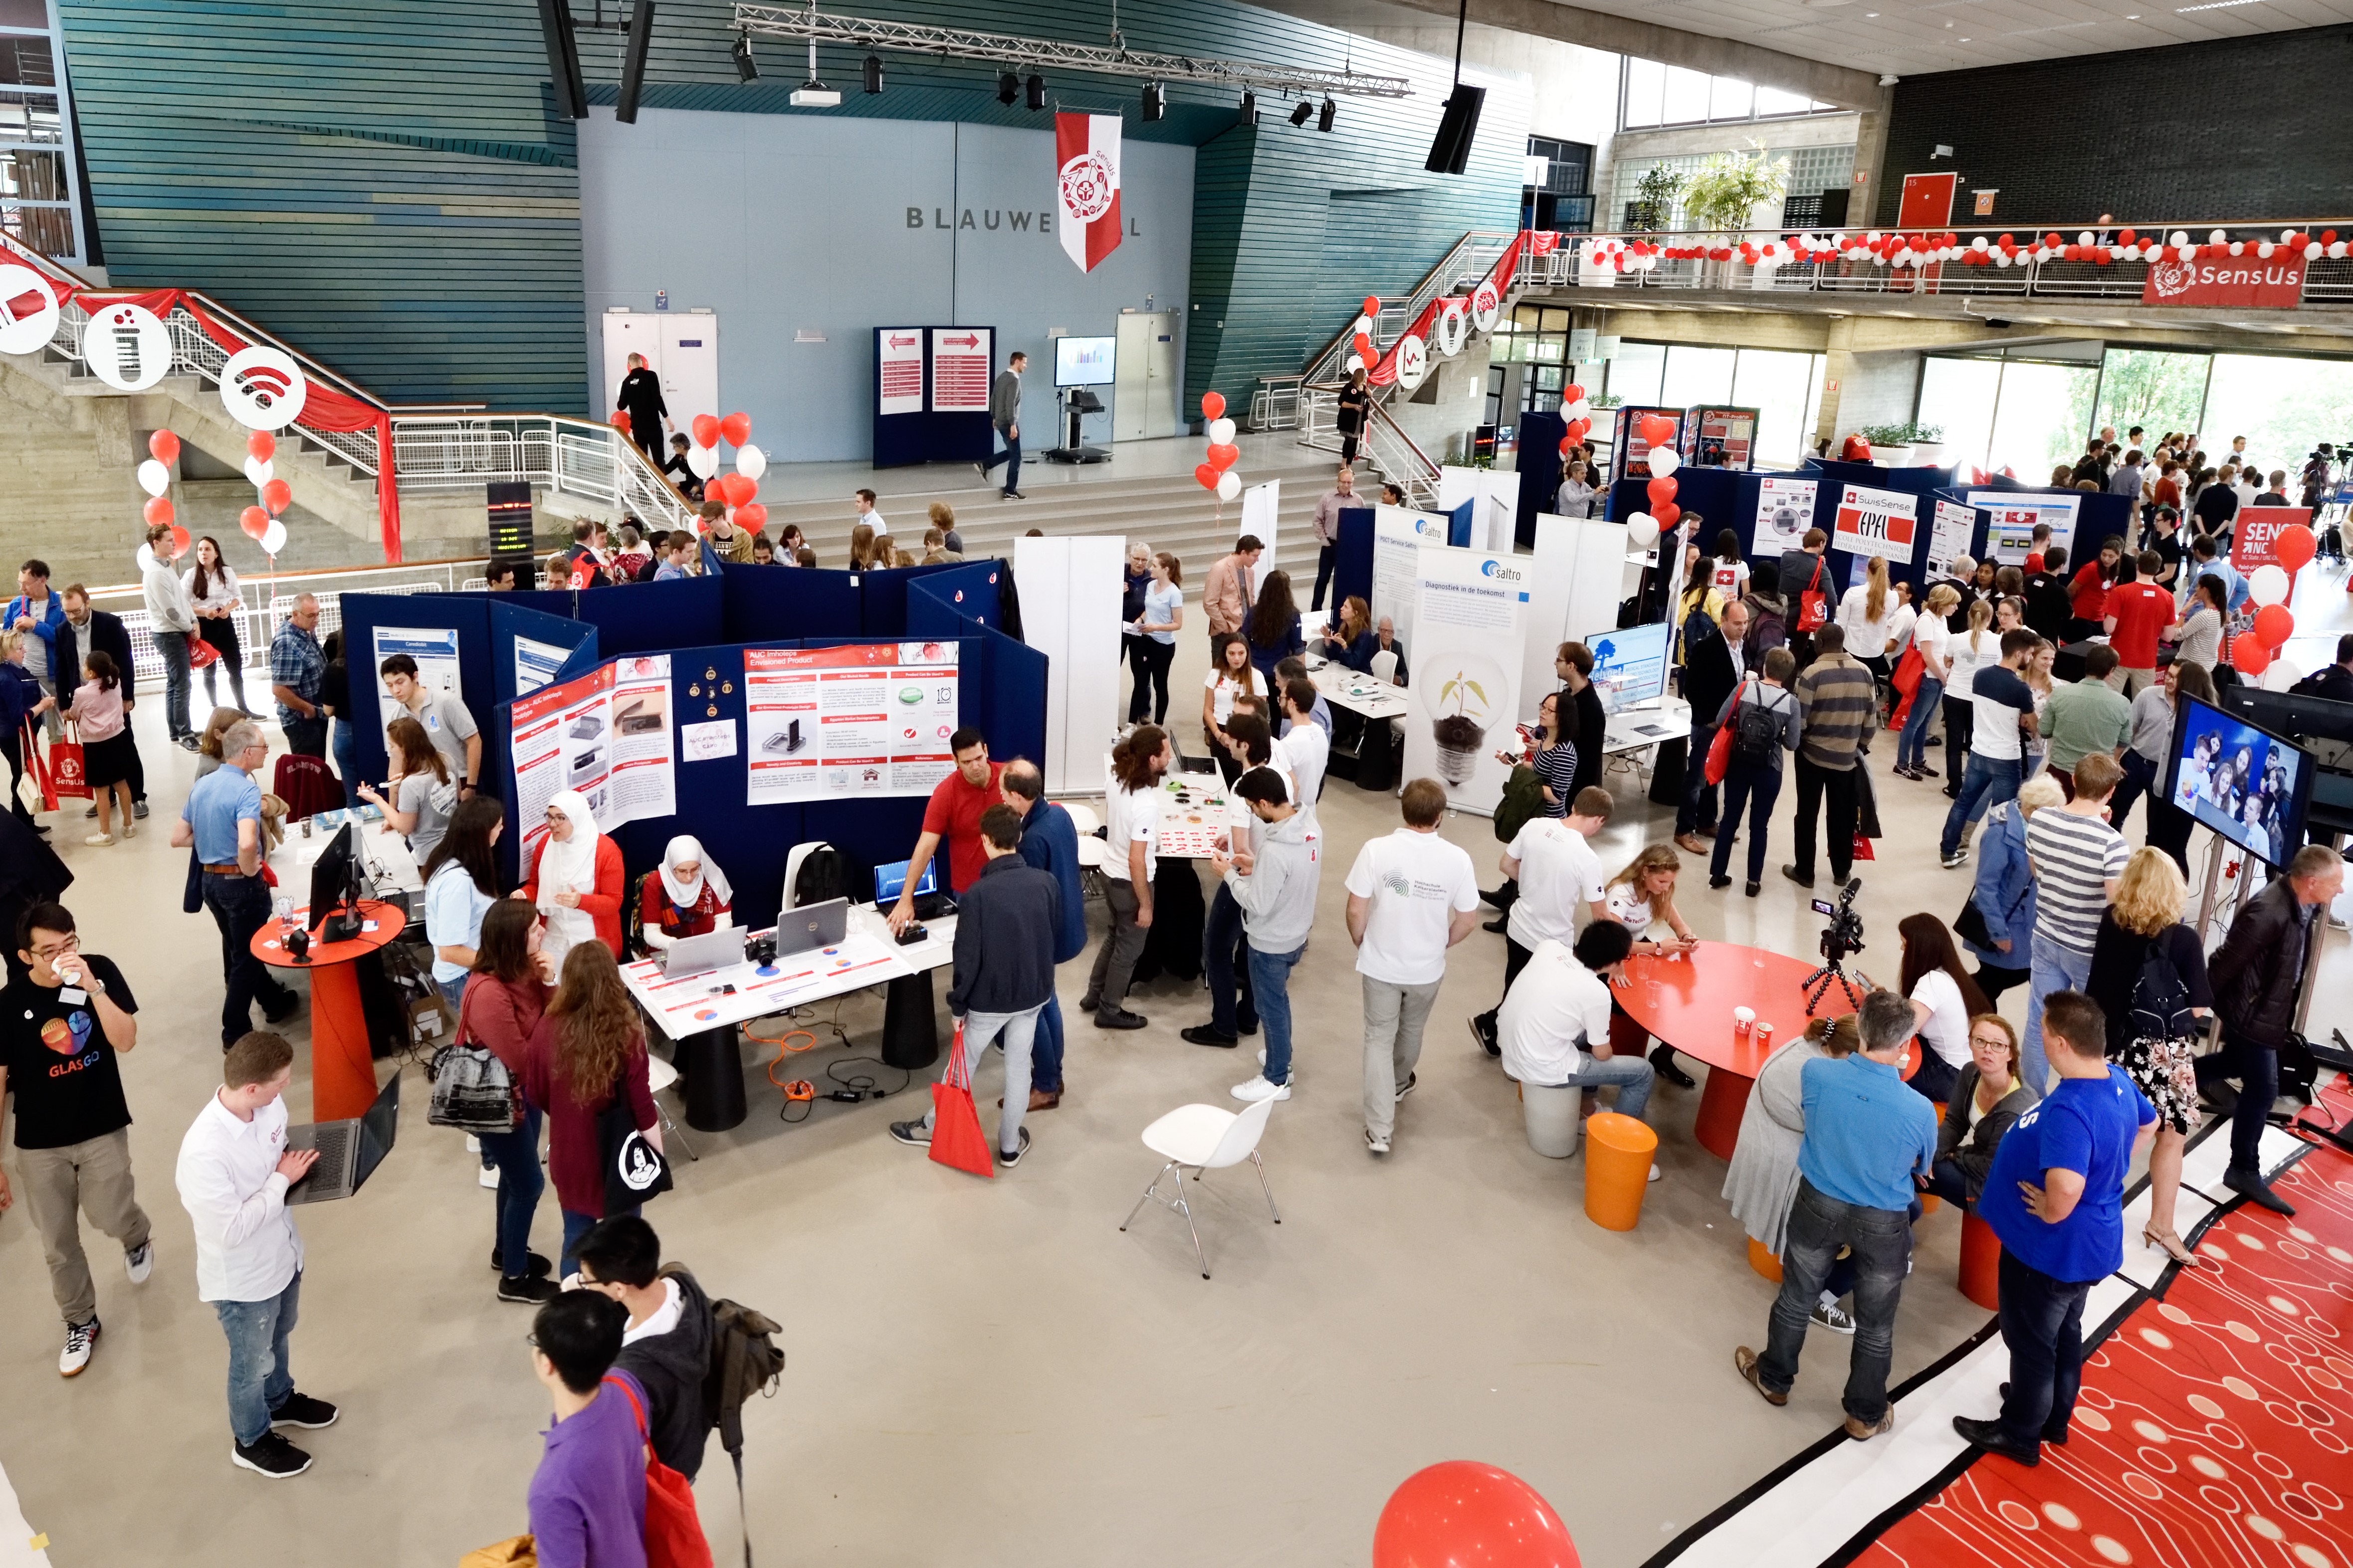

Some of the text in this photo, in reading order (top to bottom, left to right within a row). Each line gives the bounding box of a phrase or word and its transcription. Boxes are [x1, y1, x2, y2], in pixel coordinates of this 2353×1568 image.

[1096, 150, 1115, 176] SensUs
[906, 207, 1051, 232] BLAUWE
[2200, 266, 2299, 285] SensUs
[1859, 496, 1910, 511] SwisSense
[1425, 527, 1441, 538] saltro
[1861, 512, 1886, 540] EPFL
[1856, 538, 1910, 554] POLYTECHNIQUE
[2253, 542, 2269, 554] NC
[1875, 549, 1909, 562] LAUSANNE
[1496, 568, 1521, 581] saltro
[1425, 581, 1460, 590] Diagnostiek
[1477, 588, 1504, 597] toekomst
[513, 703, 529, 715] SensUs
[532, 697, 542, 705] AUC
[56, 777, 85, 785] SensUs
[49, 1051, 99, 1077] GLASGO
